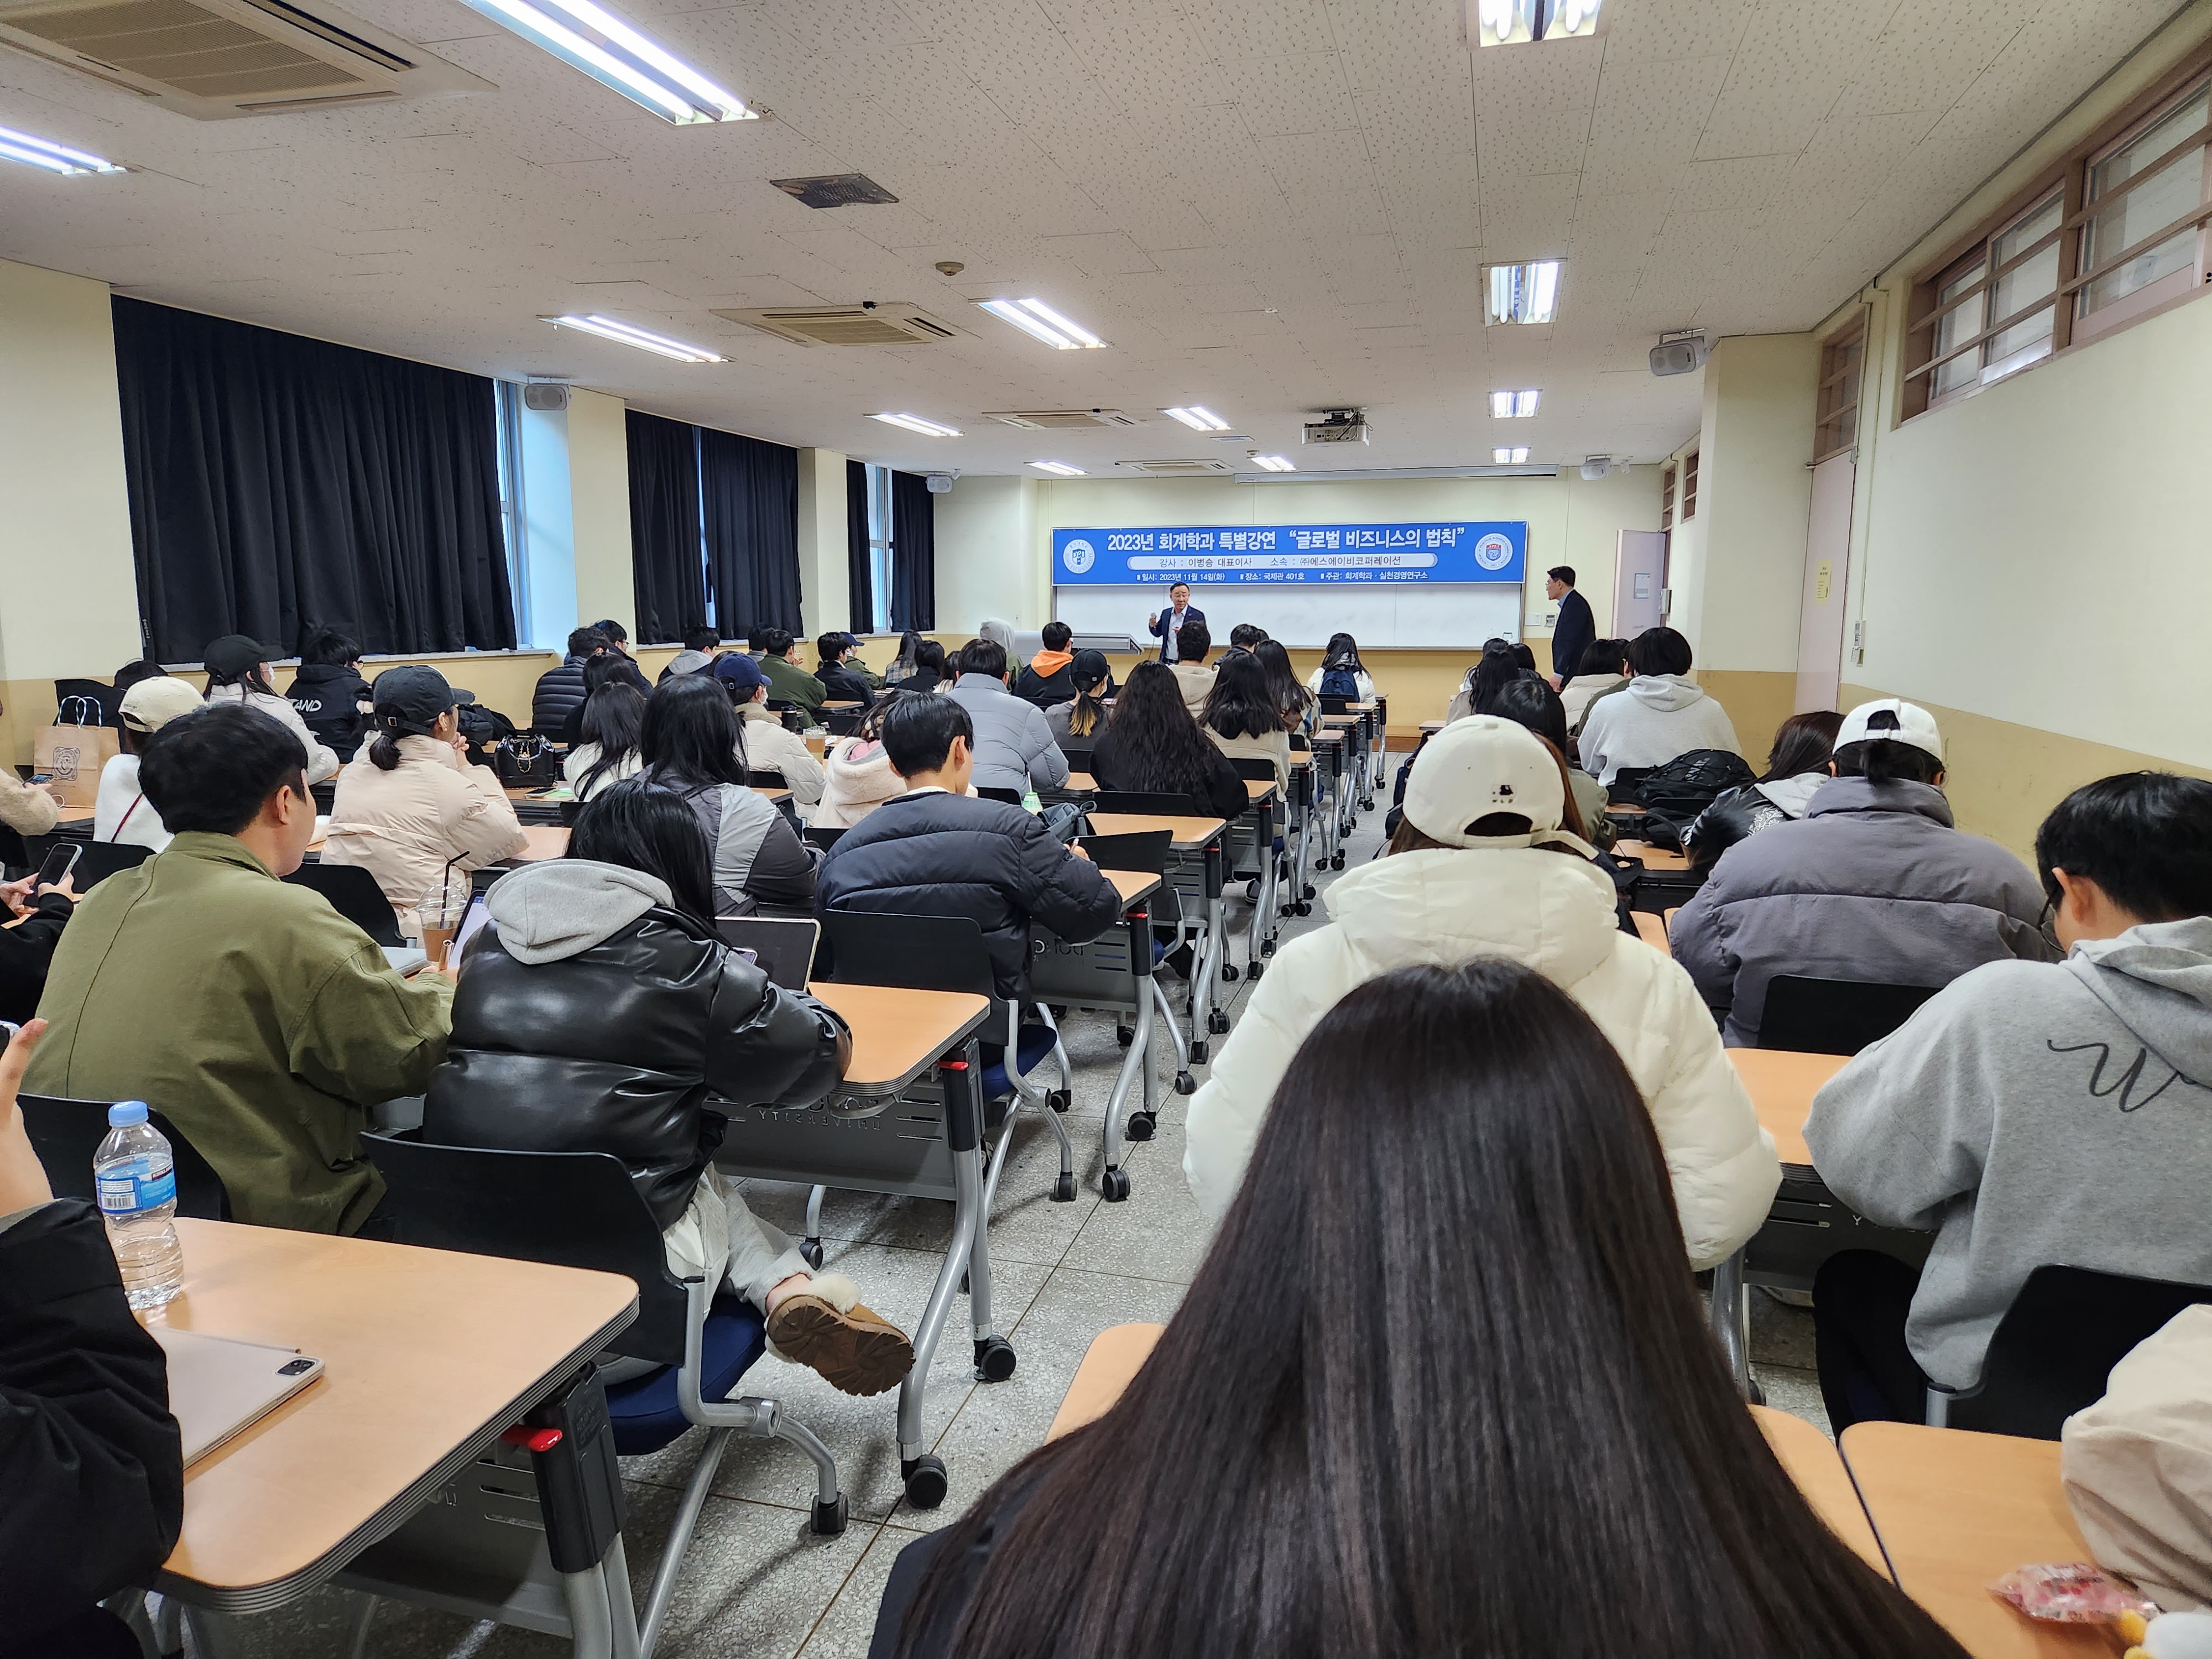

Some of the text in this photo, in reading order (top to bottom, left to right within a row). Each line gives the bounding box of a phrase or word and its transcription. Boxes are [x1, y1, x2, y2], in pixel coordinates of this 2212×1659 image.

[1108, 533, 1154, 551] 2023년
[1159, 533, 1215, 551] 회계학과
[1218, 531, 1276, 550] 특별강연
[1345, 529, 1421, 549] 비즈니스의
[1160, 558, 1176, 568] 강사
[1188, 558, 1213, 568] 이병승
[1218, 557, 1252, 567] 대표이사
[1270, 557, 1288, 566] 소속
[1159, 573, 1182, 581] 2023년
[1183, 573, 1198, 581] 11월
[1200, 572, 1225, 581] 14일(화)
[1263, 572, 1284, 581] 국제관
[1285, 572, 1305, 580] 401호
[1344, 571, 1373, 580] 회계학과
[1379, 571, 1428, 580] 실천경영연구소
